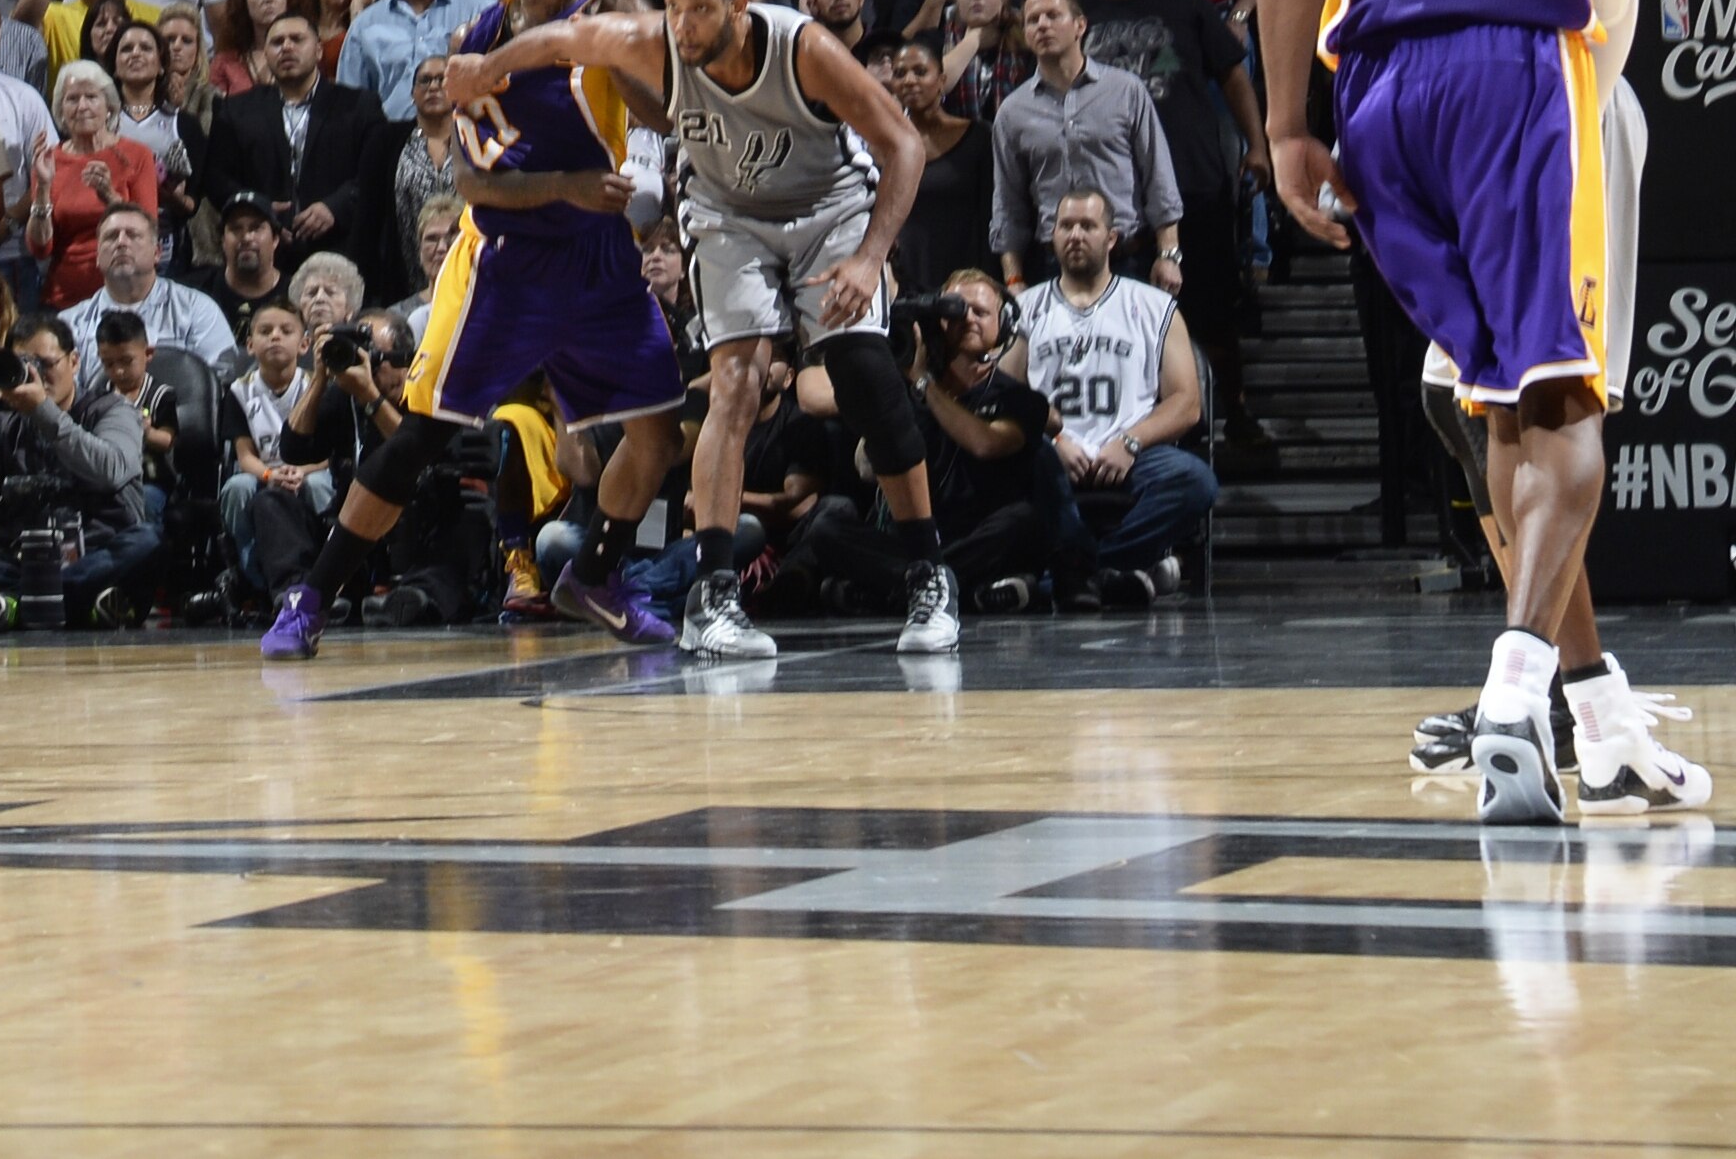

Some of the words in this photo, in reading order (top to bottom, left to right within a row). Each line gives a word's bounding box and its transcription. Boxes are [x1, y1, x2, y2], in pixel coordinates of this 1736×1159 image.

[678, 108, 732, 154] 21
[1037, 335, 1133, 366] SPURS
[1053, 374, 1118, 421] 20
[1634, 358, 1690, 415] of
[1611, 443, 1736, 512] #NB
